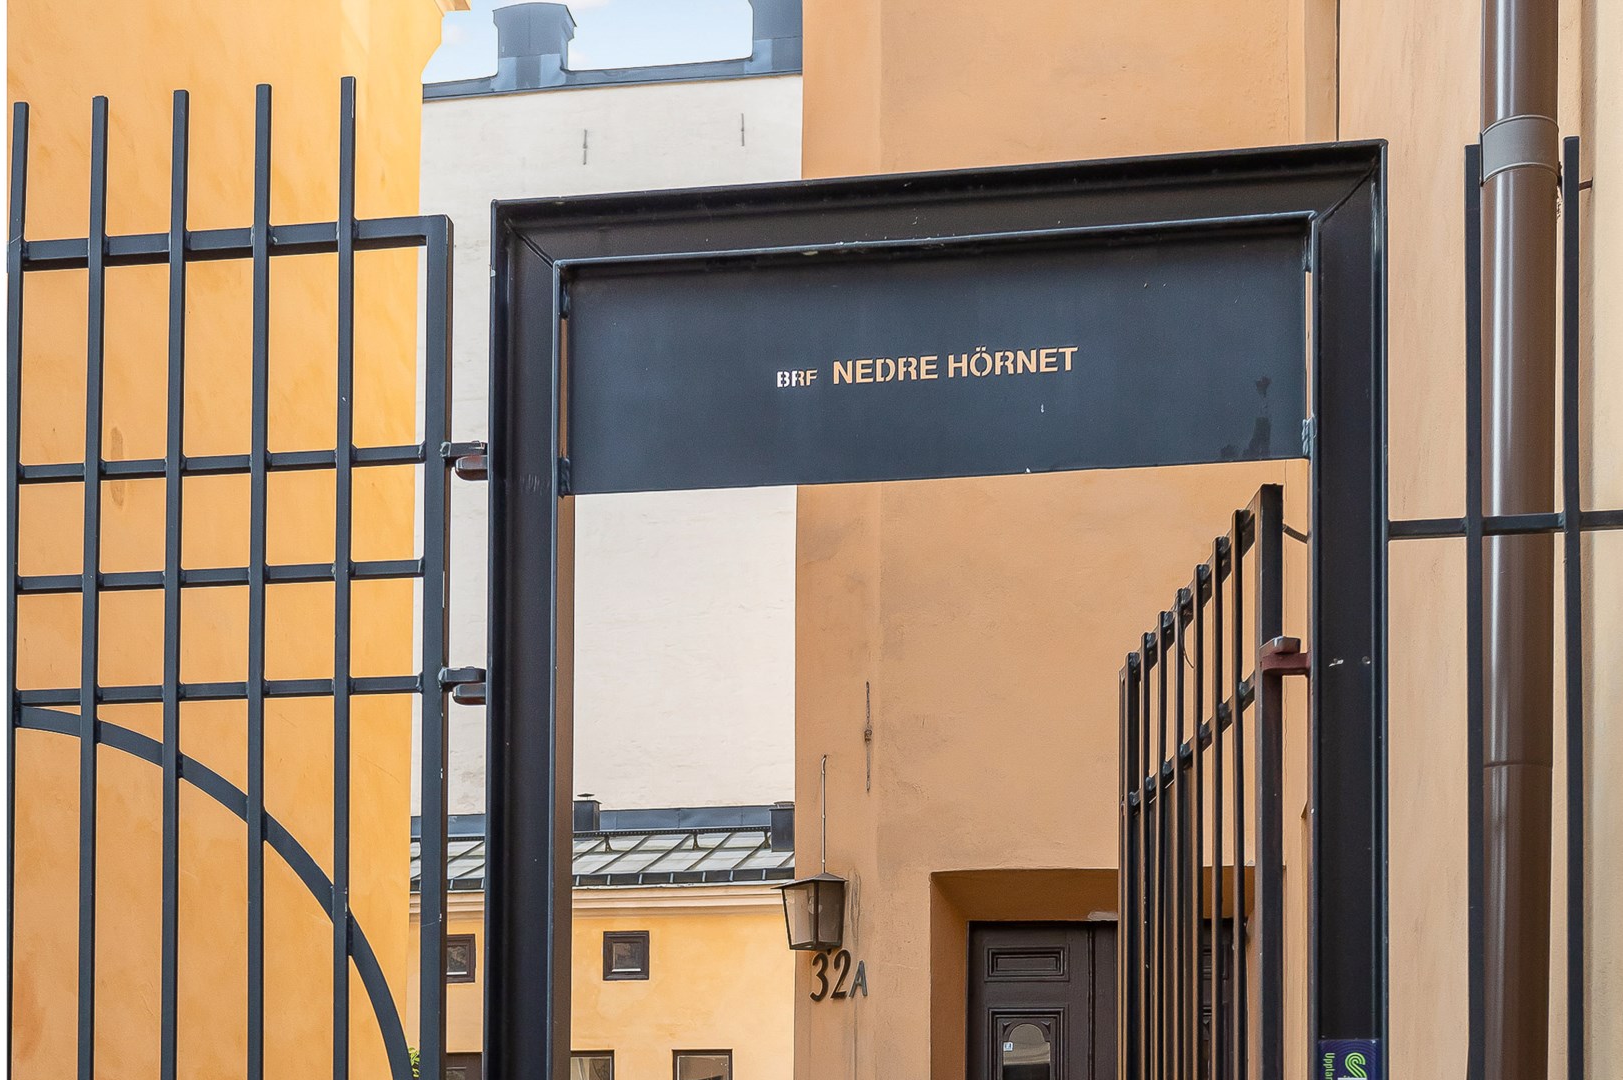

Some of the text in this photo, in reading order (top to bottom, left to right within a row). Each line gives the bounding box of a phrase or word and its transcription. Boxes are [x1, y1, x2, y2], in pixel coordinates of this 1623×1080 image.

[776, 346, 1079, 388] BRF NEDRE HÖRNET
